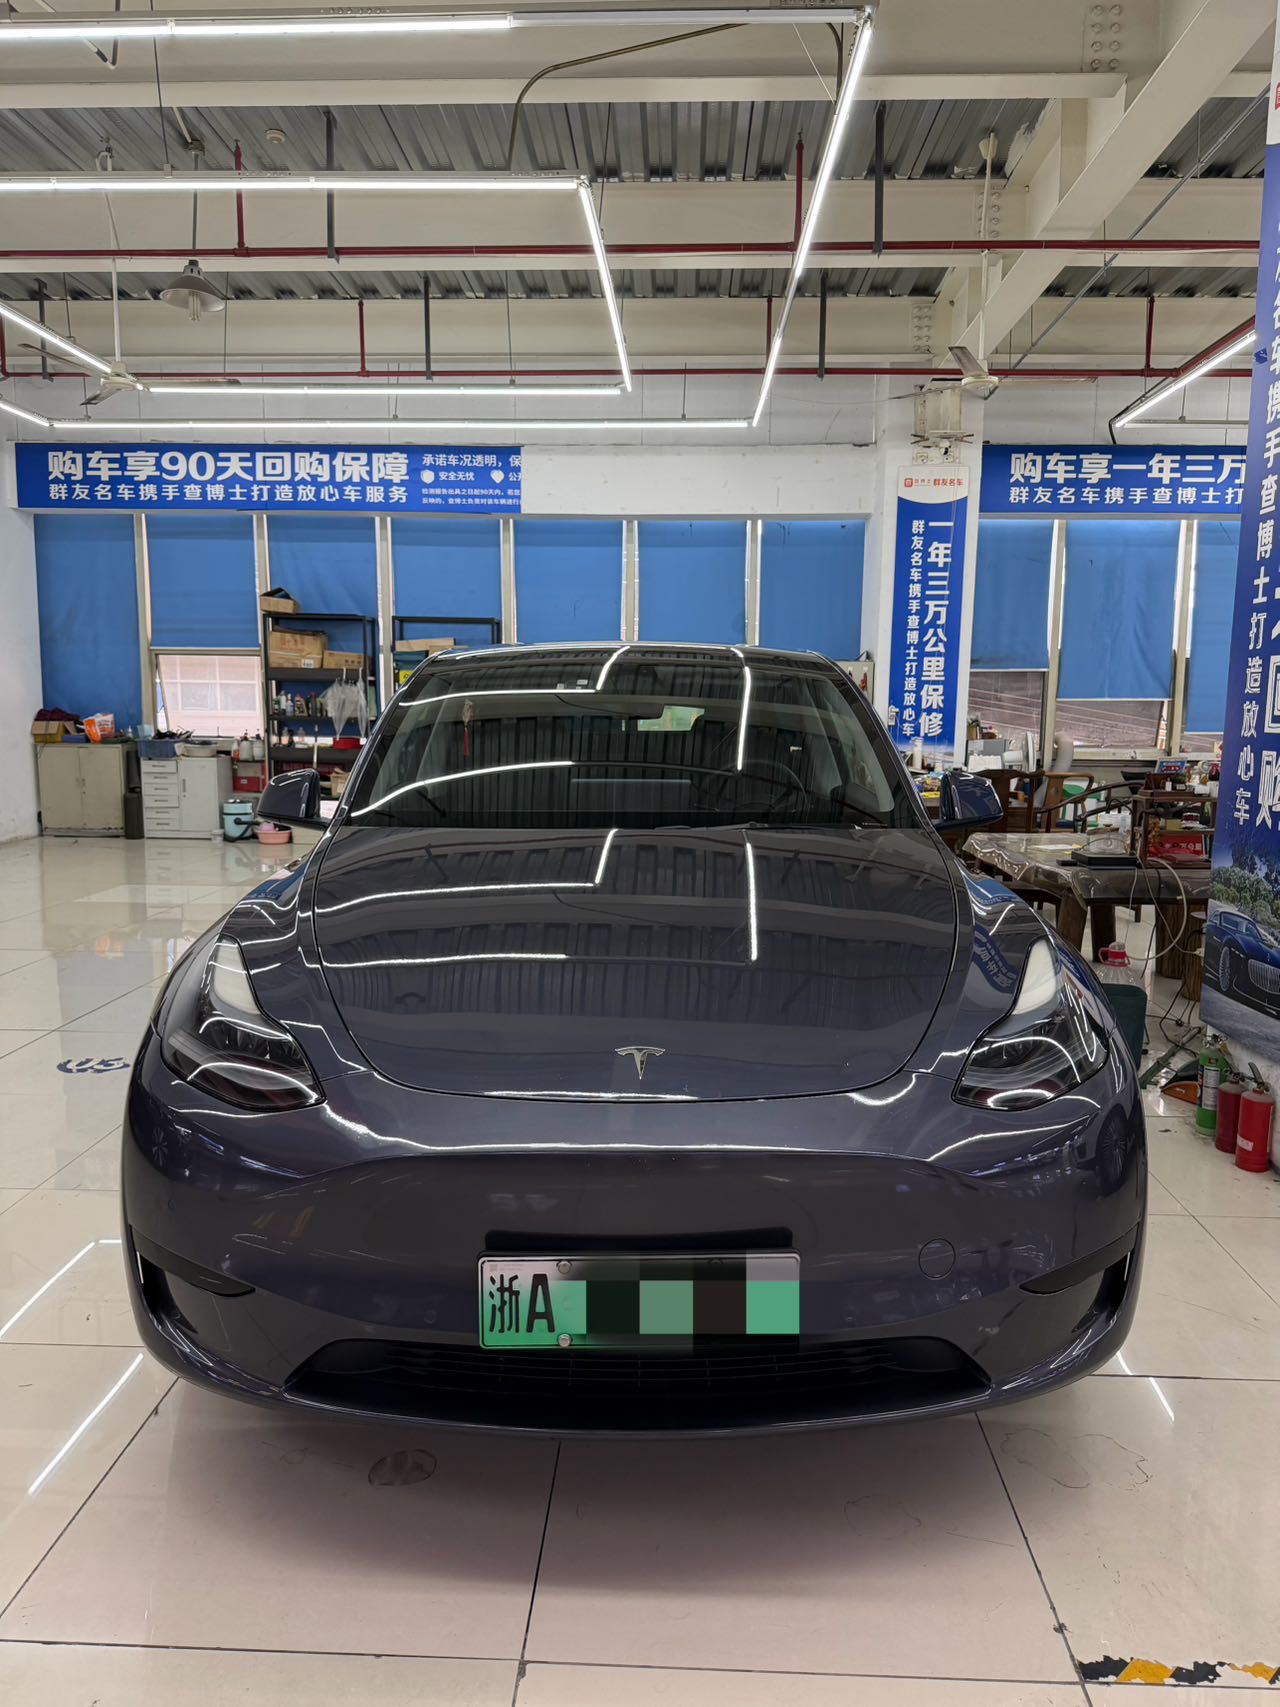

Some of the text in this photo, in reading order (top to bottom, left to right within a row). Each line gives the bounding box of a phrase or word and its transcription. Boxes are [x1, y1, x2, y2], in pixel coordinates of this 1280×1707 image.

[47, 451, 410, 482] 购车享90天回购保障
[439, 471, 475, 481] 安全无忧
[1009, 452, 1247, 485] 购车享一年三万
[48, 484, 408, 503] 群友名车携手查博士打造放心车服务
[1009, 486, 1244, 505] 群友名车携手查博士打
[902, 519, 925, 737] 群友名车携手查博士打造放心车
[918, 521, 954, 738] 一年三万公里保修
